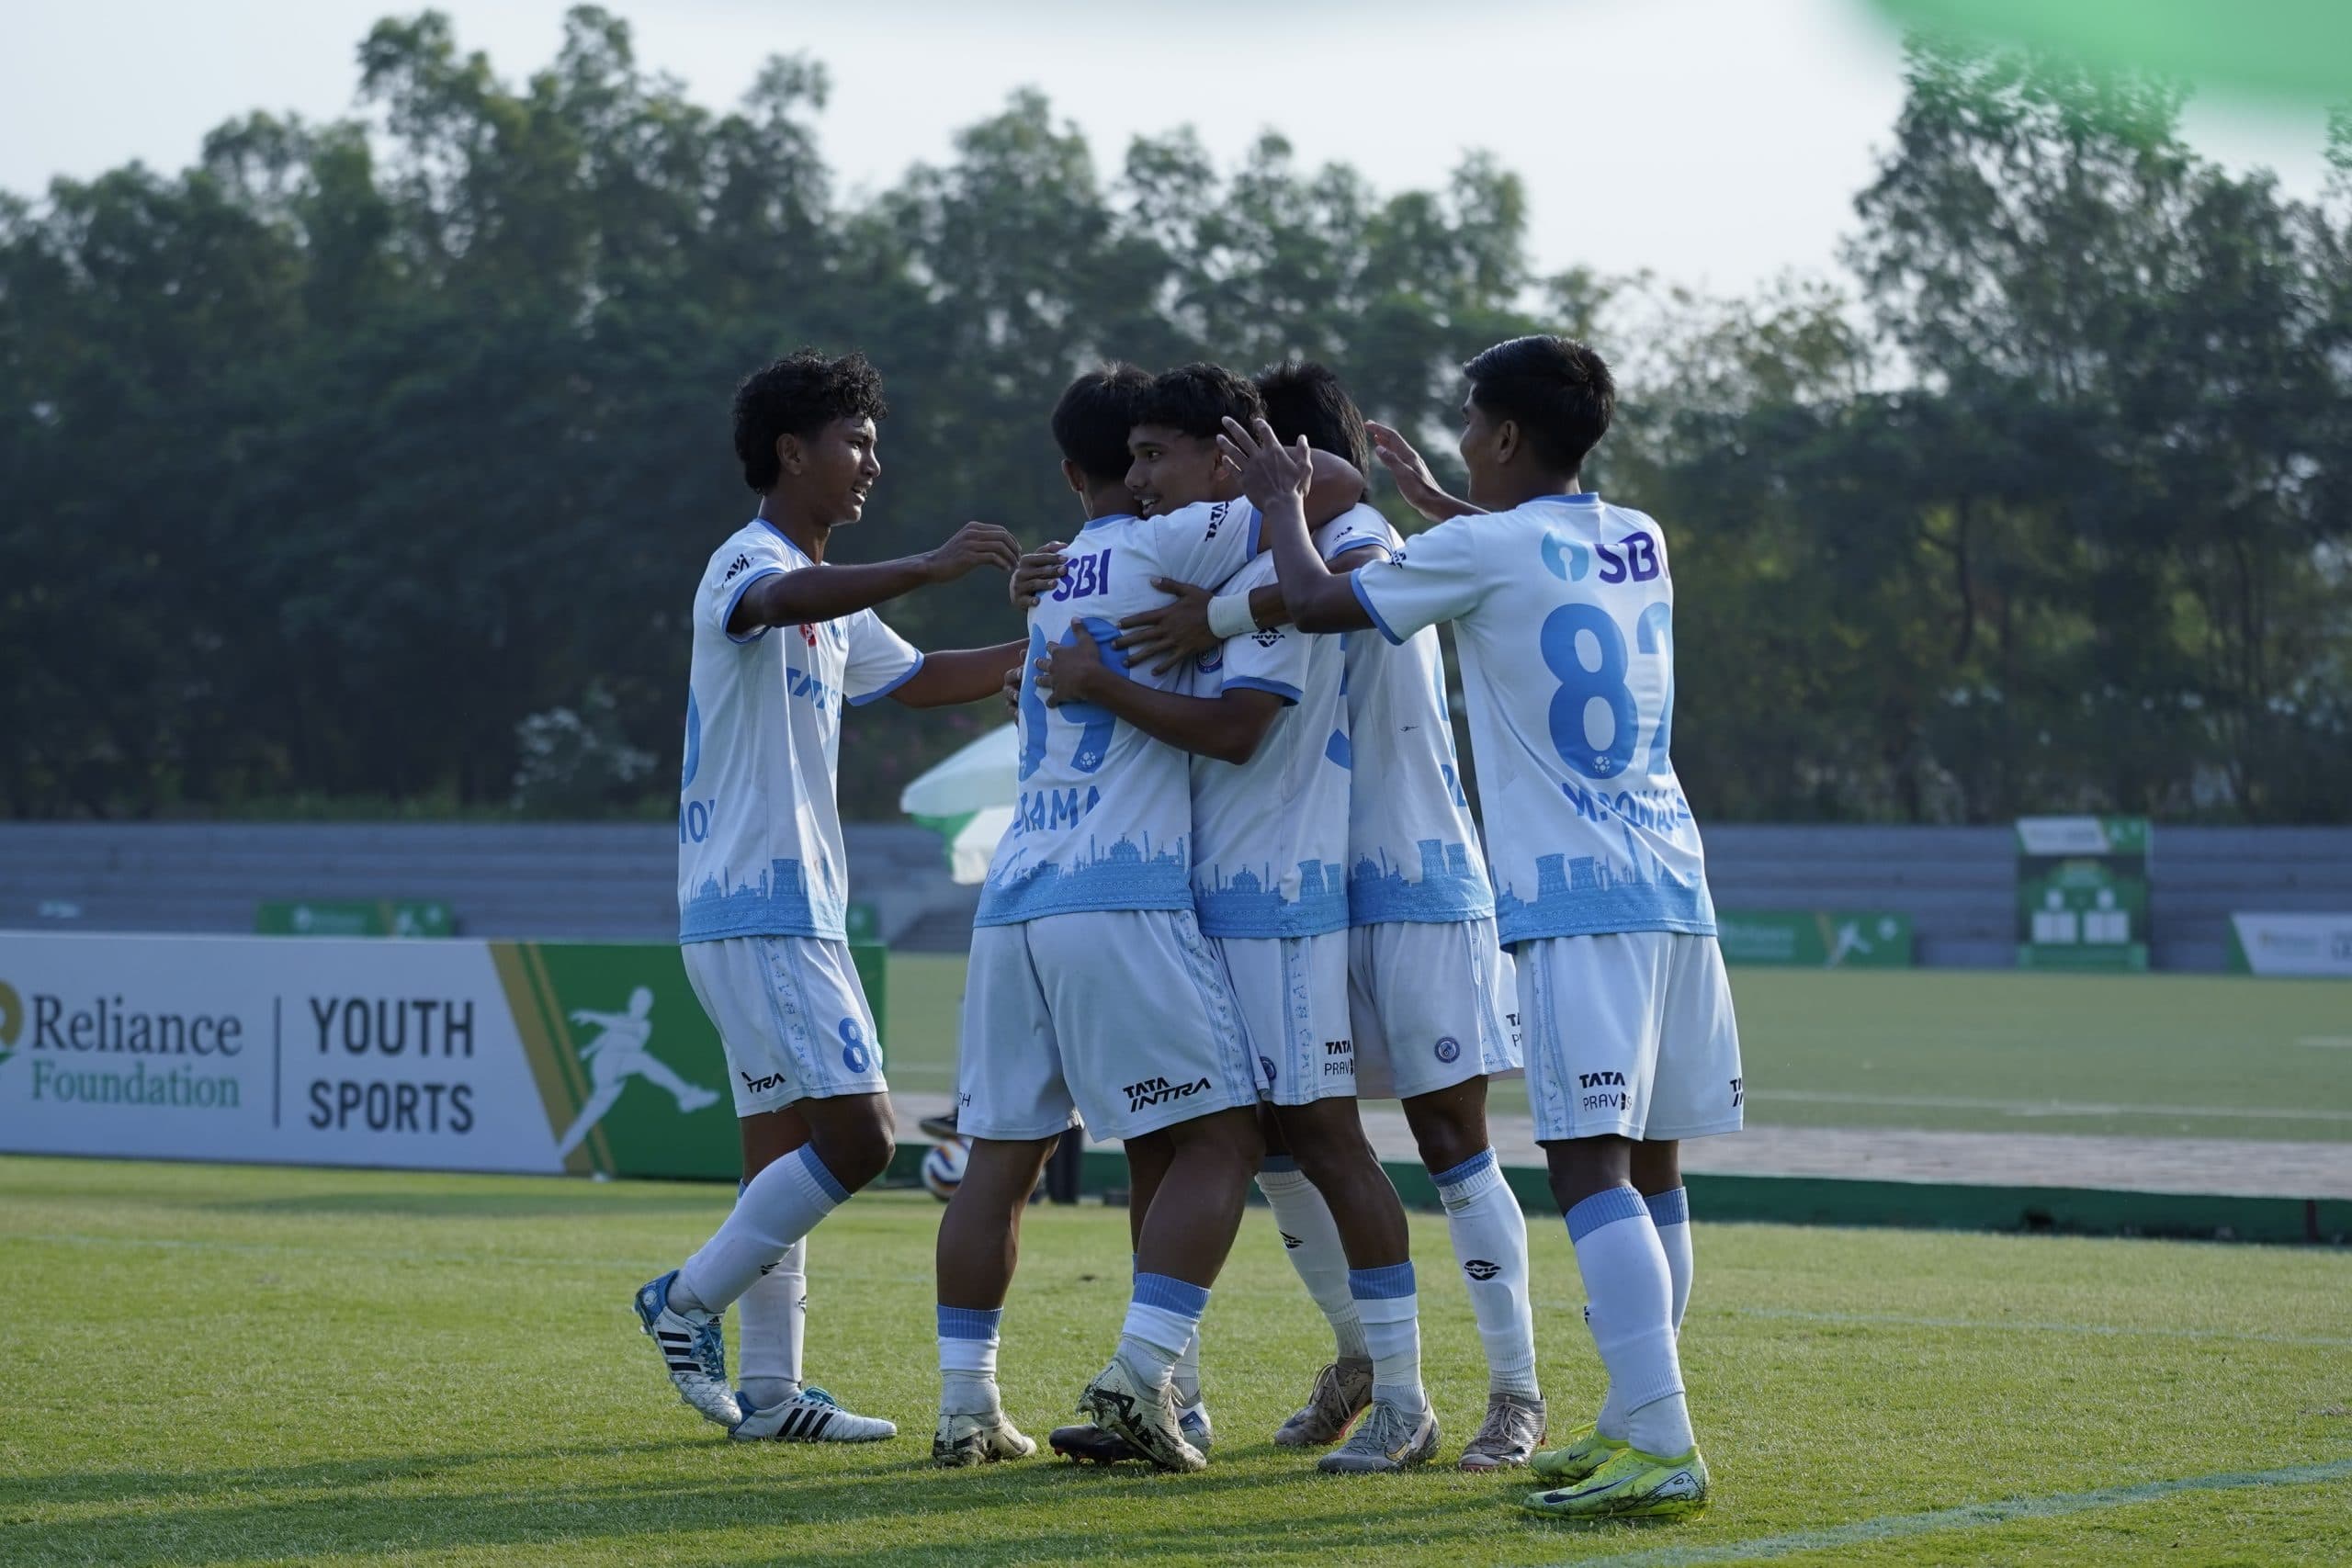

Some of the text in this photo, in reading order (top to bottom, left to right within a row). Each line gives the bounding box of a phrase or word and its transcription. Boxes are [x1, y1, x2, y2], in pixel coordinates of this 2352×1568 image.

[1051, 548, 1111, 603] SBI
[1540, 602, 1672, 780] 82
[30, 994, 243, 1056] Reliance
[308, 997, 475, 1058] YOUTH
[838, 1017, 871, 1074] 8
[31, 1060, 241, 1108] Foundation
[308, 1079, 476, 1136] SPORTS
[1123, 1077, 1170, 1099] TATA
[1130, 1077, 1212, 1113] INTRA
[1579, 1072, 1625, 1089] TATA
